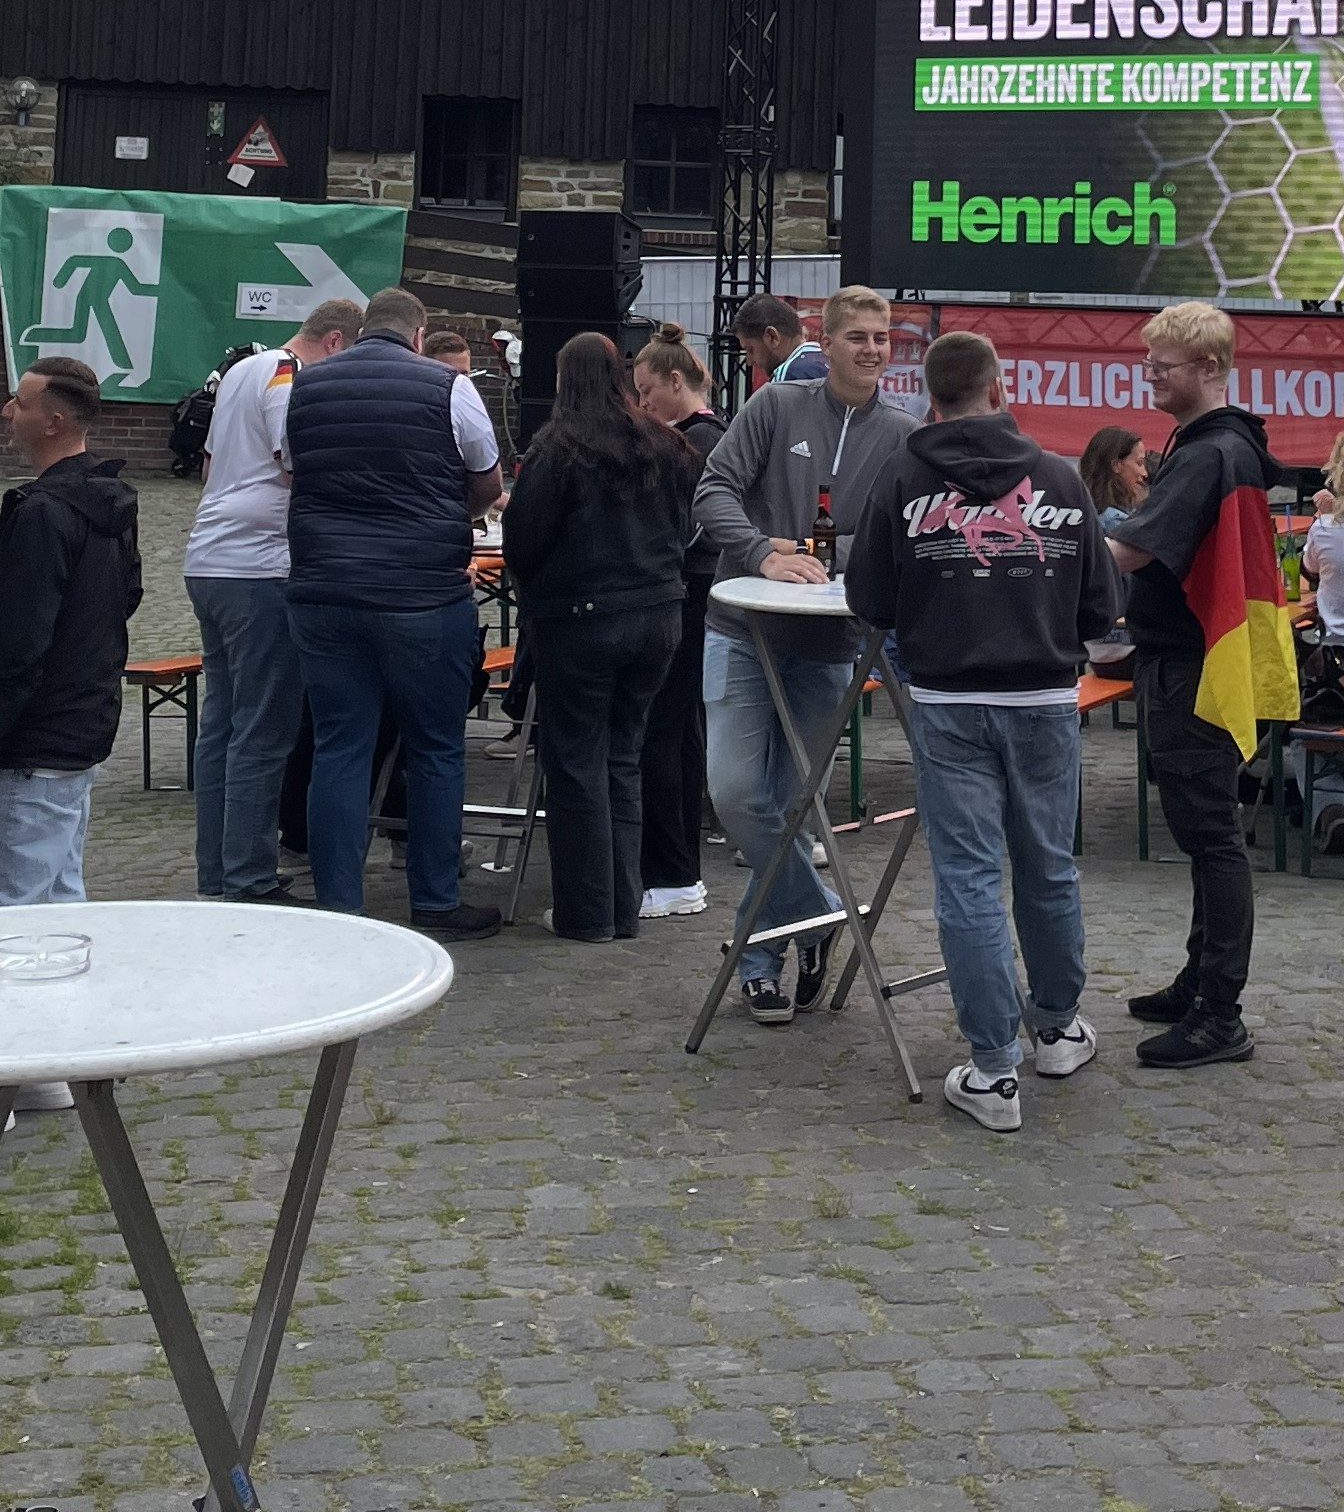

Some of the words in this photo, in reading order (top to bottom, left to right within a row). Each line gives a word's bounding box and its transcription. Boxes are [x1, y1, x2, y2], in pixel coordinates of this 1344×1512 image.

[922, 62, 1115, 105] JAHRZEHNTE
[1121, 60, 1313, 104] KOMPETENZ
[248, 290, 273, 304] WC
[879, 368, 924, 396] rüh
[999, 359, 1156, 410] ERZLICH
